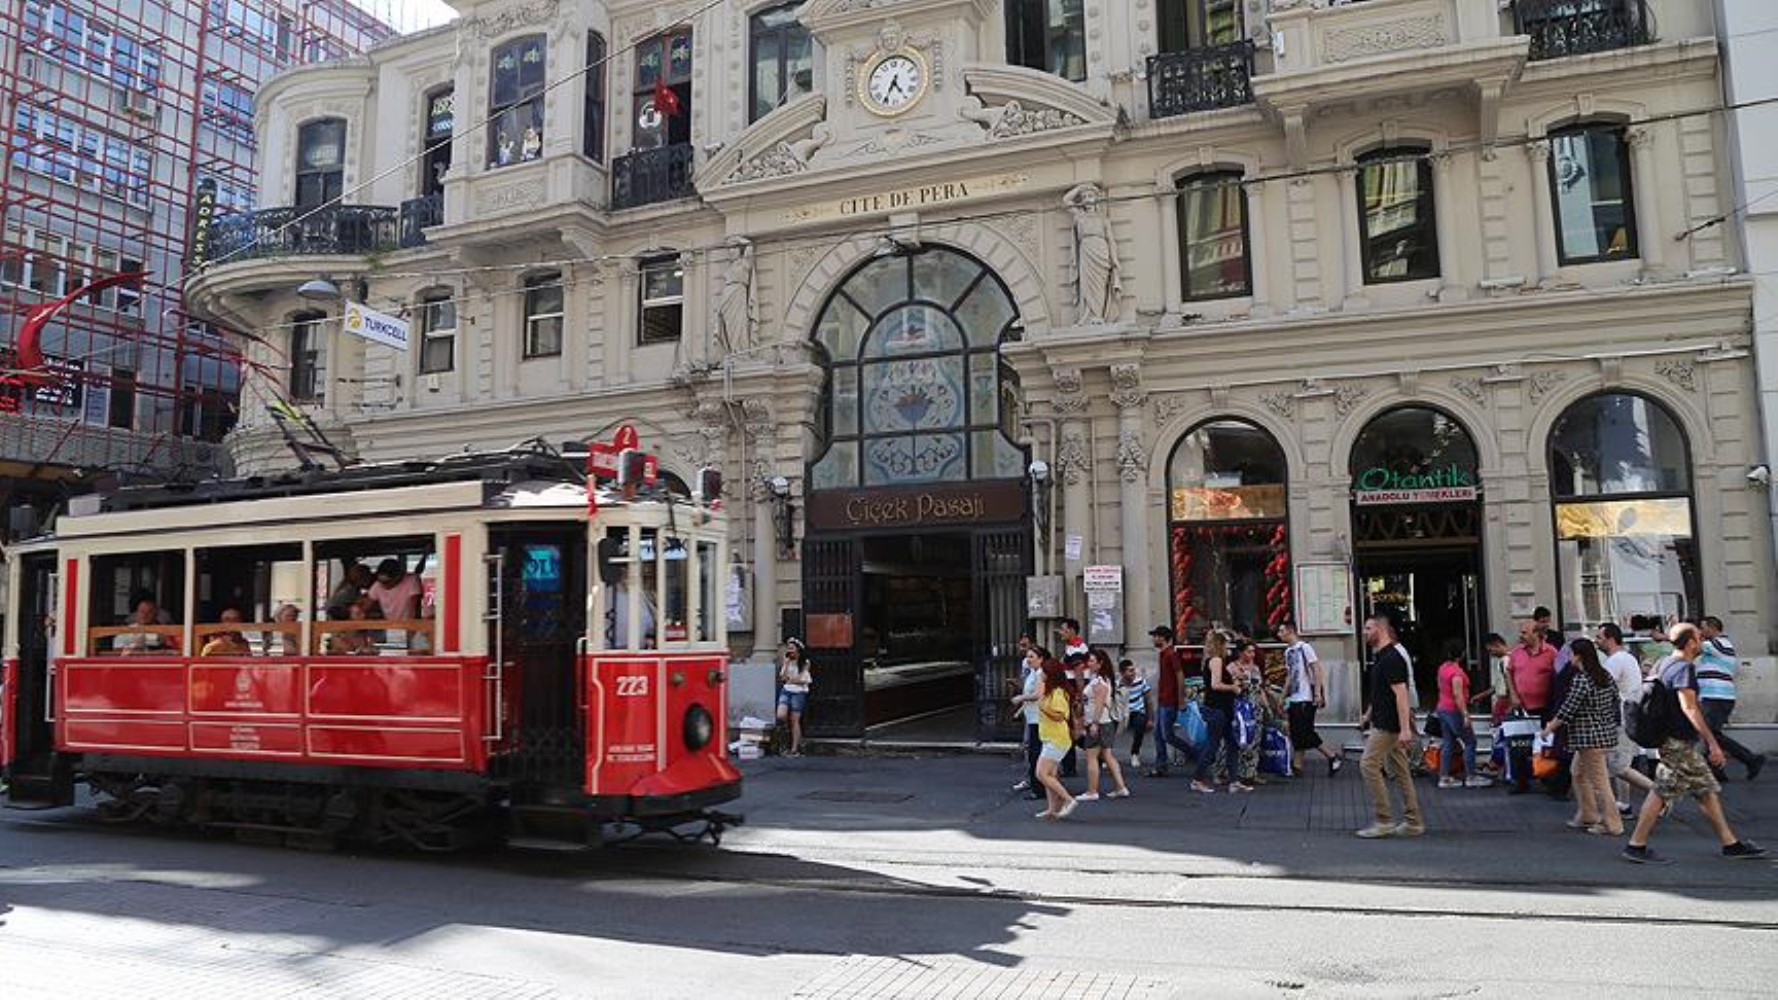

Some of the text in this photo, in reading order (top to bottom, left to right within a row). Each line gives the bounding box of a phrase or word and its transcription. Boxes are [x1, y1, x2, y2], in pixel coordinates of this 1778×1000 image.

[889, 190, 914, 208] DE
[919, 182, 969, 204] PERA
[365, 316, 408, 342] TURKCELL
[1360, 463, 1470, 491] Otantik
[1361, 491, 1410, 502] ANADOLU
[846, 497, 908, 525] Çiçek
[616, 675, 649, 696] 223
